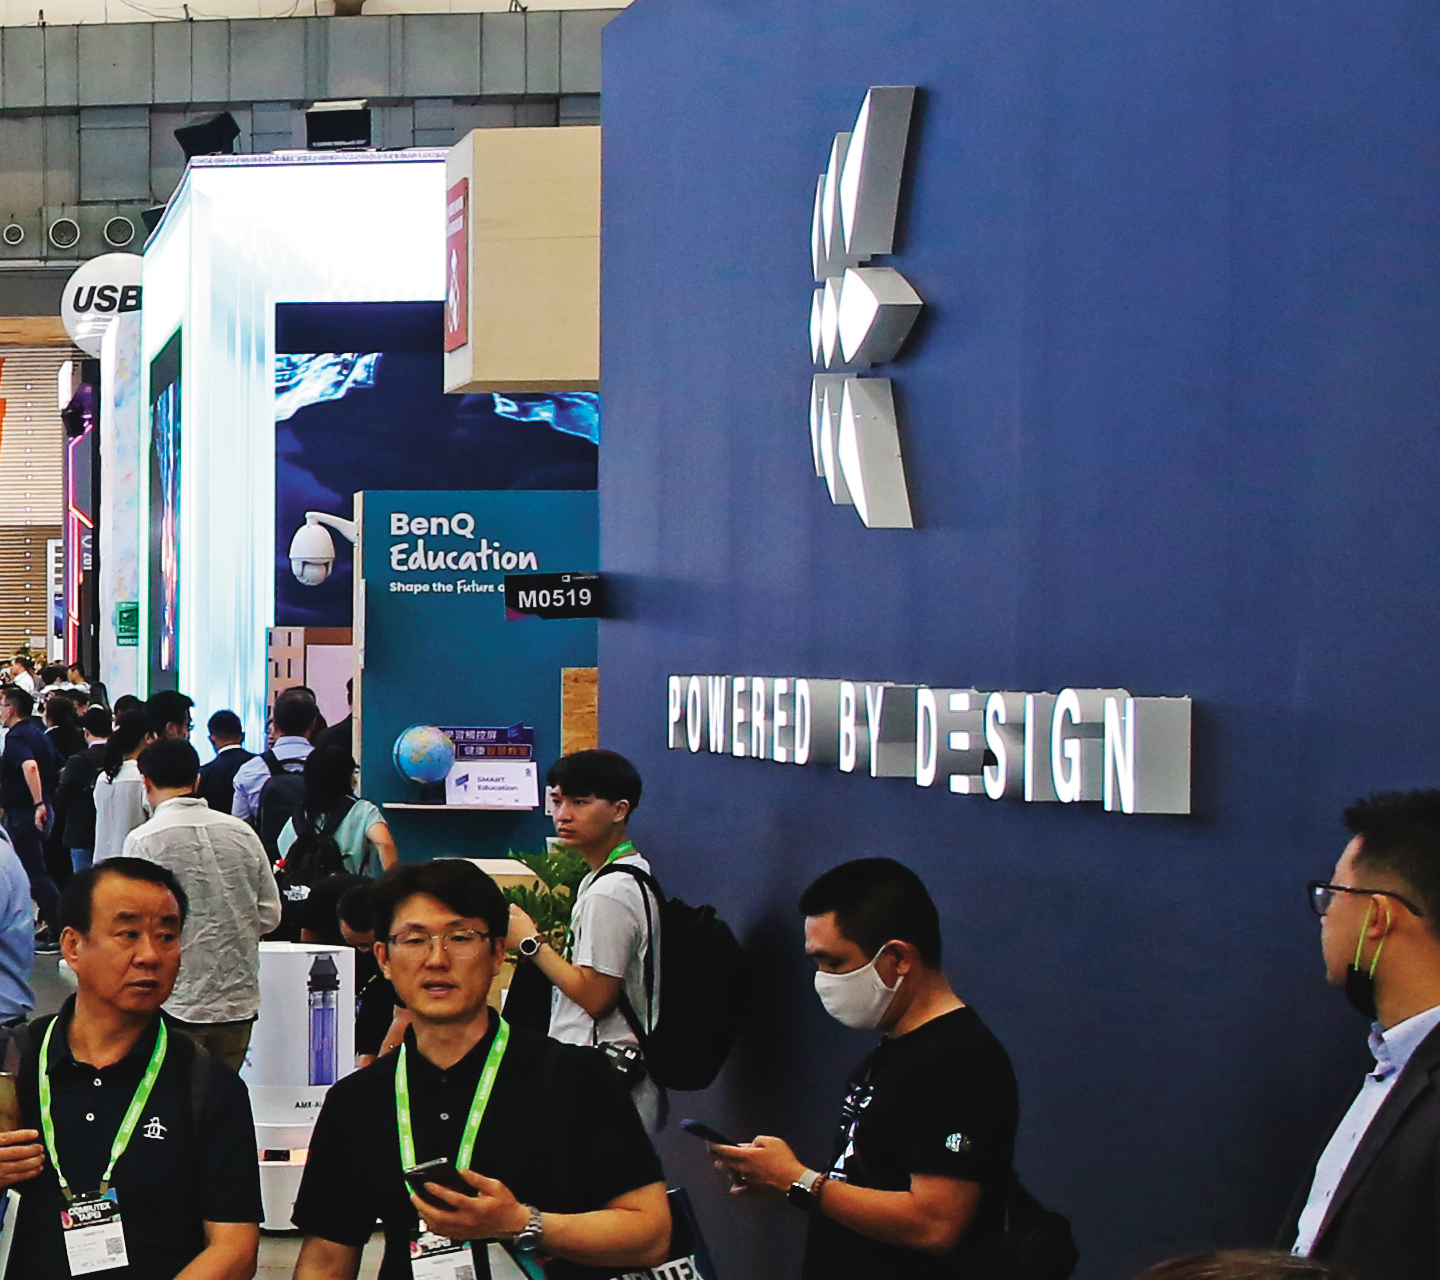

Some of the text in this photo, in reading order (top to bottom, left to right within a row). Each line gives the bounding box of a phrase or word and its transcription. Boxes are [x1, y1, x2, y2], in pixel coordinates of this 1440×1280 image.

[73, 285, 143, 313] USB
[390, 512, 475, 539] BenQ
[389, 538, 538, 572] Education
[389, 579, 495, 595] Shape the Future
[518, 588, 592, 608] M0519
[667, 674, 1137, 815] POWERED BY DESIGN
